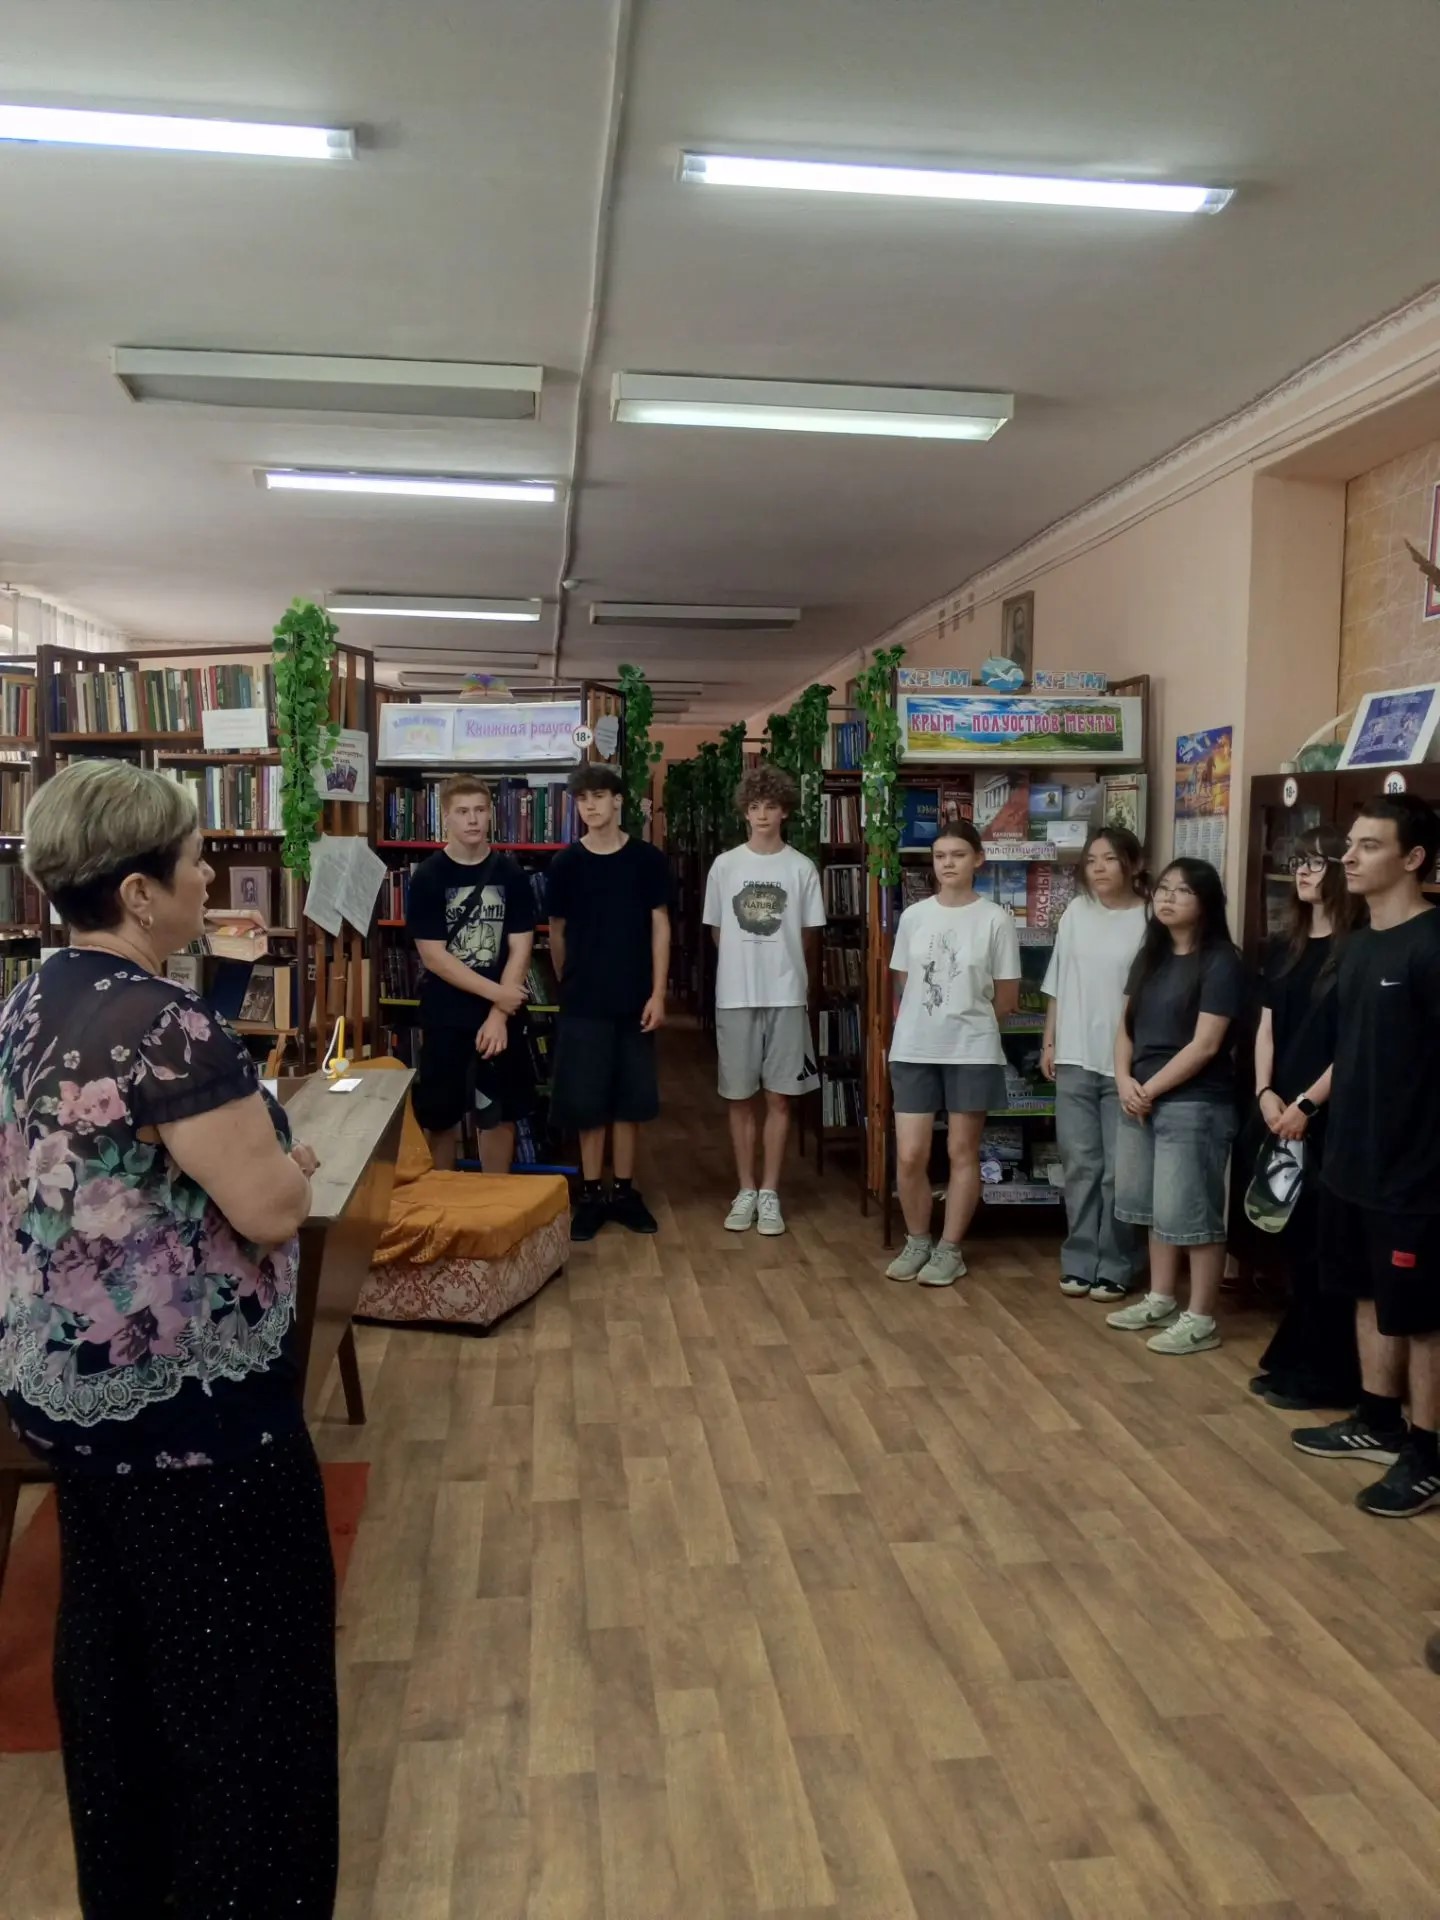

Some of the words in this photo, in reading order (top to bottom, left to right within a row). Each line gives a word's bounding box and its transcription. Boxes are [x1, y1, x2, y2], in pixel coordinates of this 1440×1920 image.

[898, 668, 970, 688] КРЫМ
[1033, 671, 1107, 691] КРЫМ
[466, 718, 526, 738] Книжная
[530, 719, 571, 741] радуга
[911, 712, 955, 734] КРЫМ
[971, 712, 1061, 735] ПОЛУОСТРОВ
[1063, 712, 1116, 733] МЕЧТЫ
[744, 881, 782, 889] CREATED
[744, 901, 777, 910] NATURE
